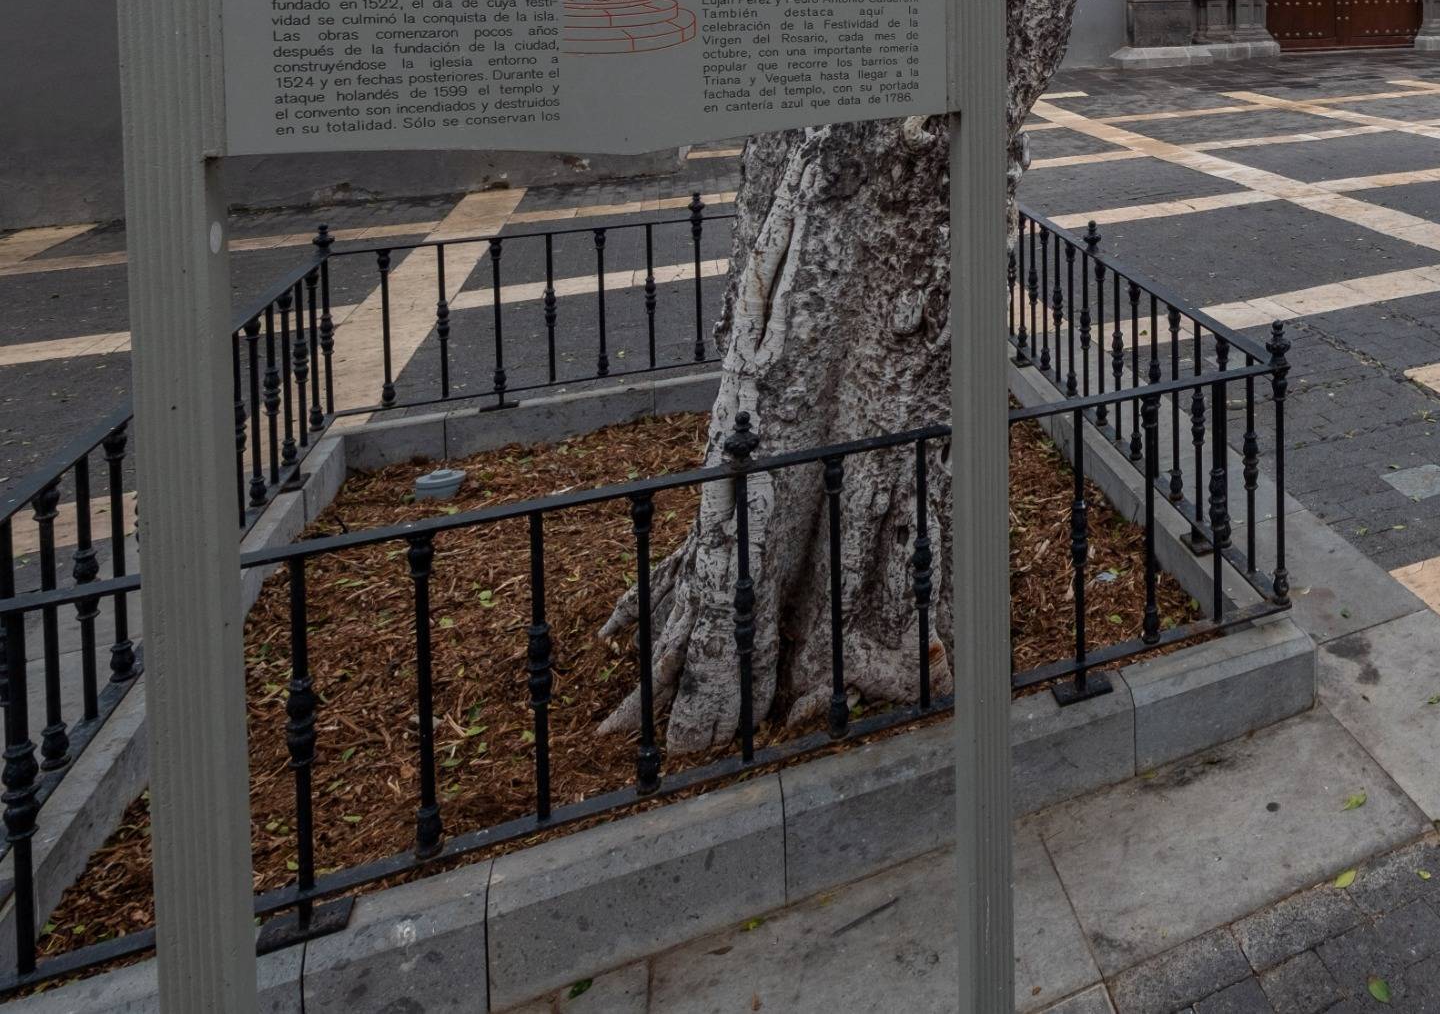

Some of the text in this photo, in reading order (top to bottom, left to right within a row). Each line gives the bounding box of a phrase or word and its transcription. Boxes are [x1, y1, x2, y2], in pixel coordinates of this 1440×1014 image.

[270, 11, 559, 26] vidad se culminó la conquista de la isla.
[701, 17, 919, 32] celebración de la Festividad de la
[275, 68, 560, 89] 1524 y en fechas posteriores. Durante el
[704, 68, 920, 87] Triana y Vegueta hasta llegar a la
[273, 82, 560, 105] ataque holandés de 1599 el templo y
